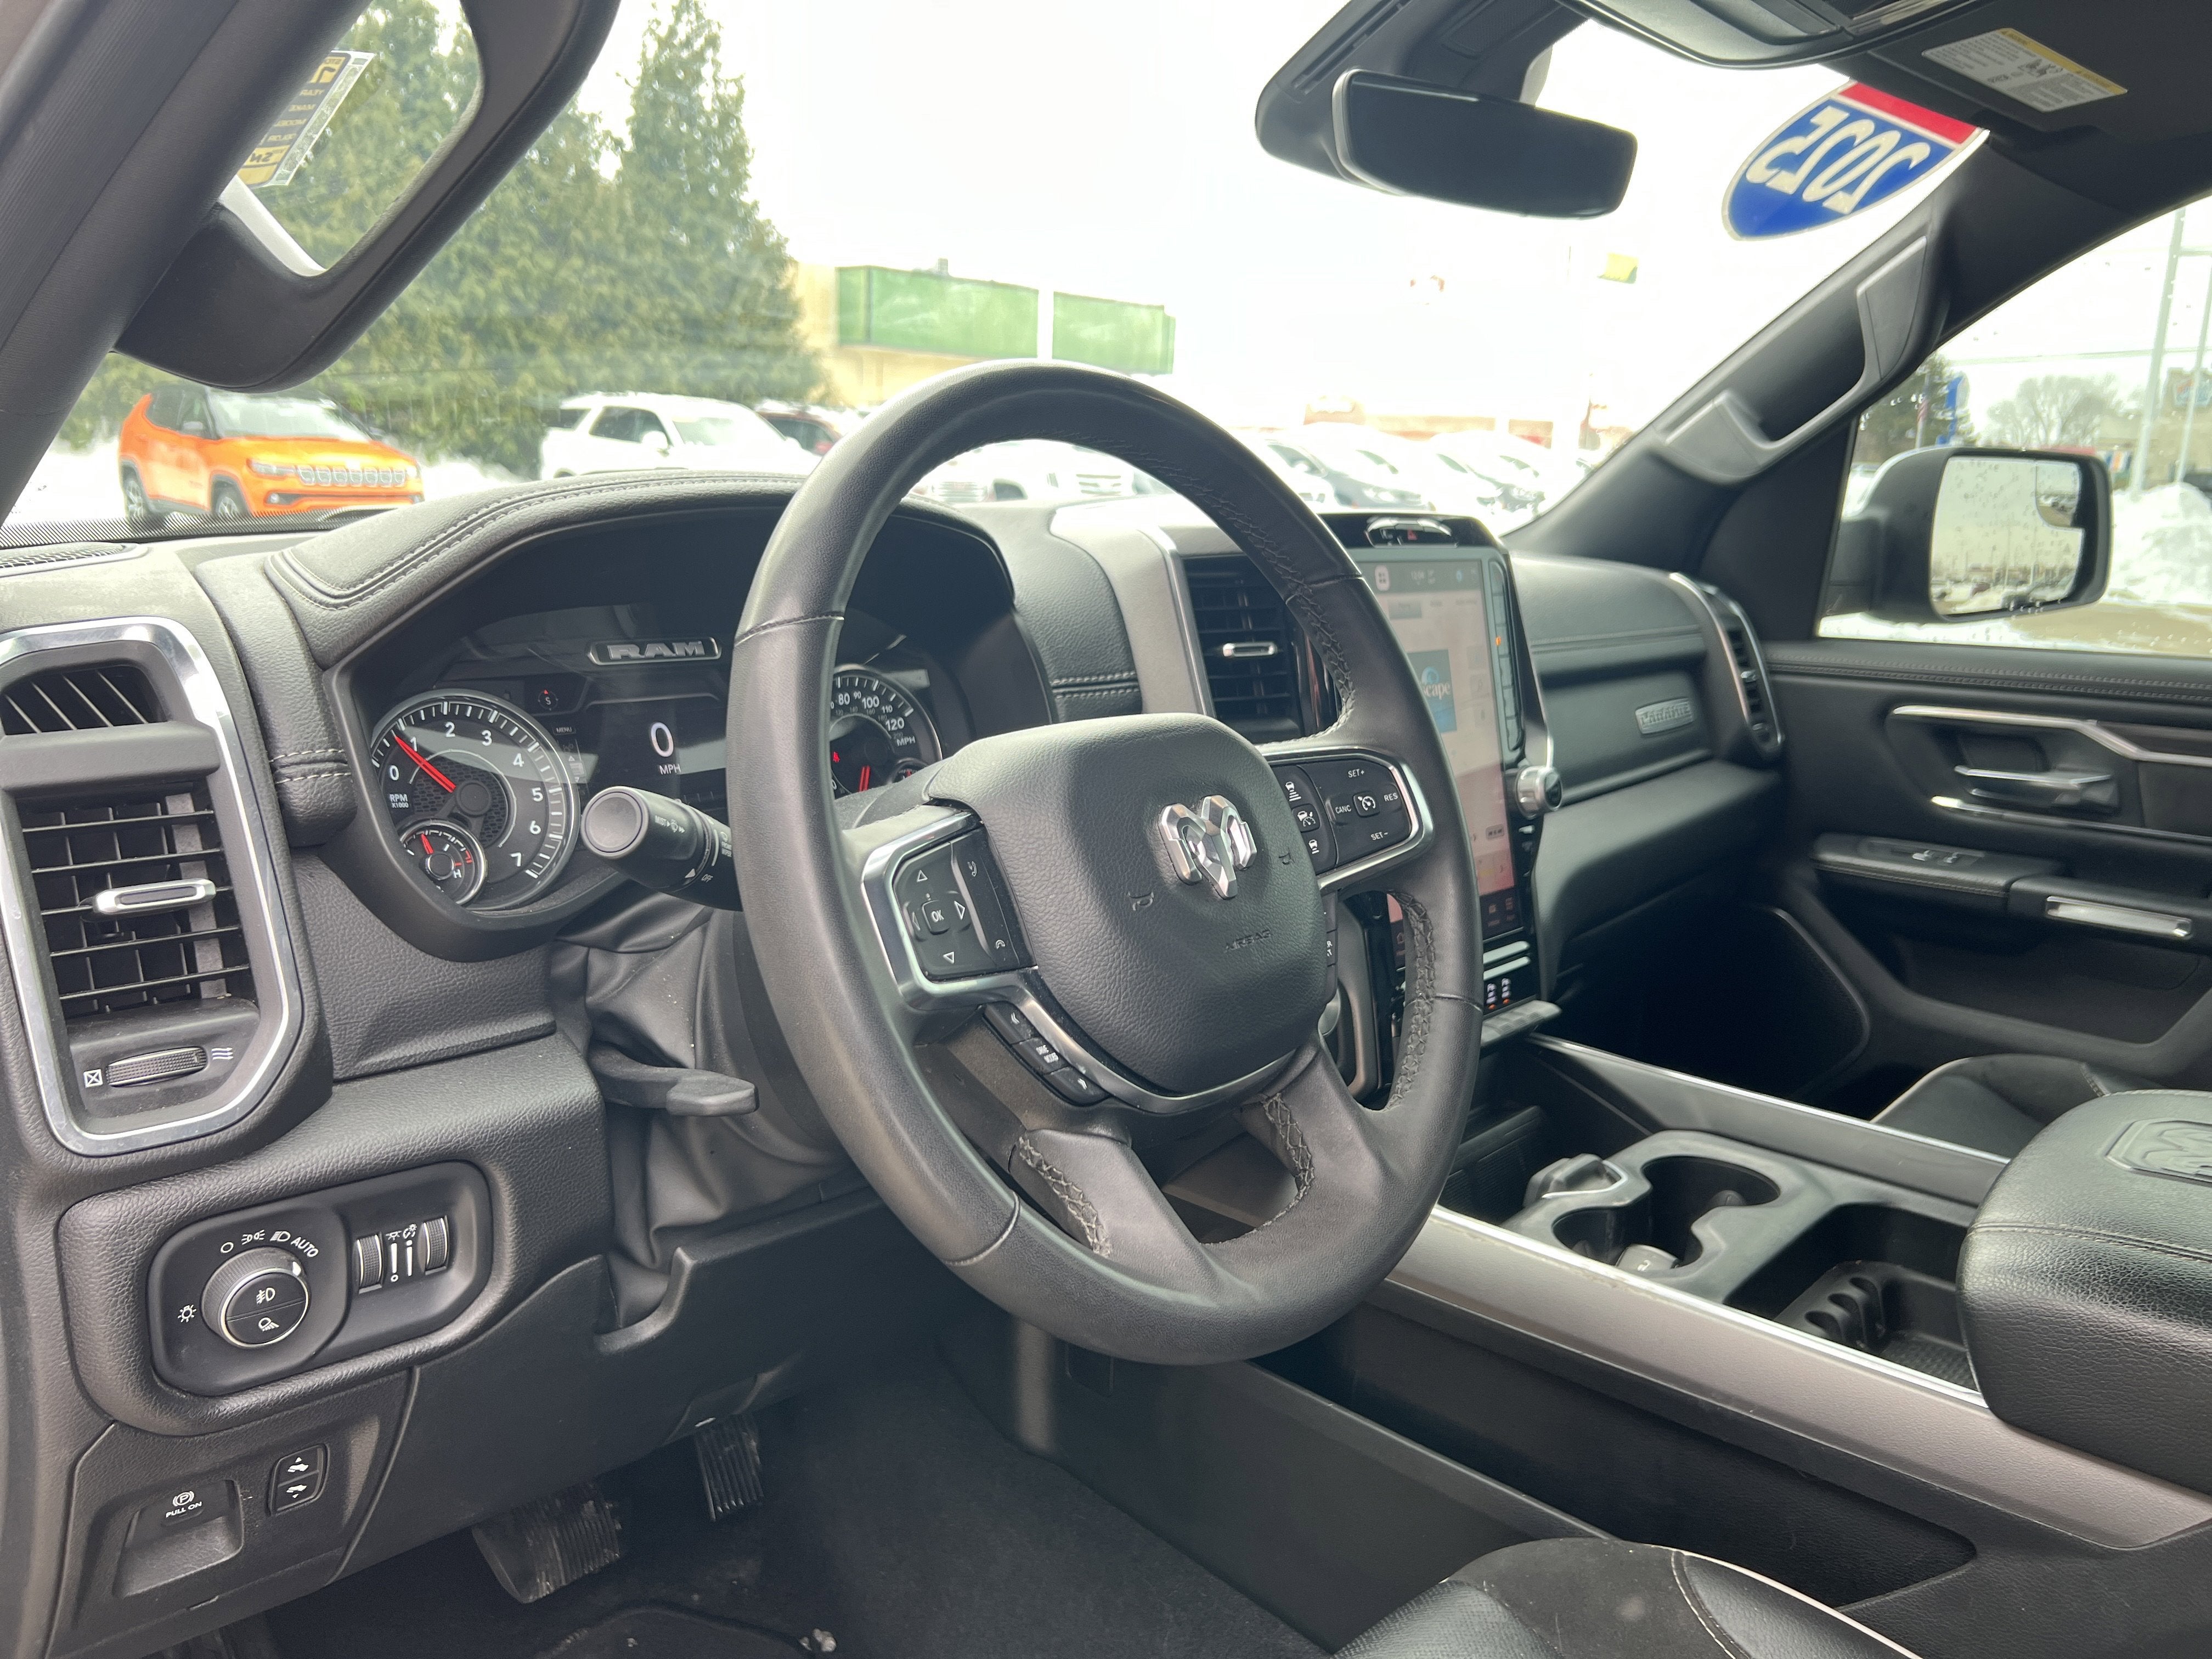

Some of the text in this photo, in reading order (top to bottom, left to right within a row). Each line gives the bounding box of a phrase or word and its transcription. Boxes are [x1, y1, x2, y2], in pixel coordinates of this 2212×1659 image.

[607, 641, 705, 659] RAM
[838, 692, 850, 705] 80
[853, 691, 861, 699] 90
[861, 695, 879, 709] 100
[882, 705, 893, 713] 110
[445, 722, 455, 737] 2
[885, 717, 905, 731] 120
[410, 737, 417, 751] 1
[482, 730, 492, 746] 3
[651, 721, 674, 757] 0
[896, 736, 916, 746] MPH
[514, 753, 524, 767] 4
[389, 765, 399, 780] 0
[659, 764, 681, 775] MPH
[390, 793, 408, 802] RPM
[532, 788, 543, 802] 5
[1384, 792, 1398, 802] RES
[1335, 805, 1351, 814] CANC
[530, 821, 541, 834] 6
[510, 852, 522, 867] 7
[454, 869, 462, 878] H
[702, 873, 713, 883] OFF
[931, 910, 944, 922] OK
[291, 1237, 319, 1257] AUTO
[166, 1501, 202, 1517] PULL ON
